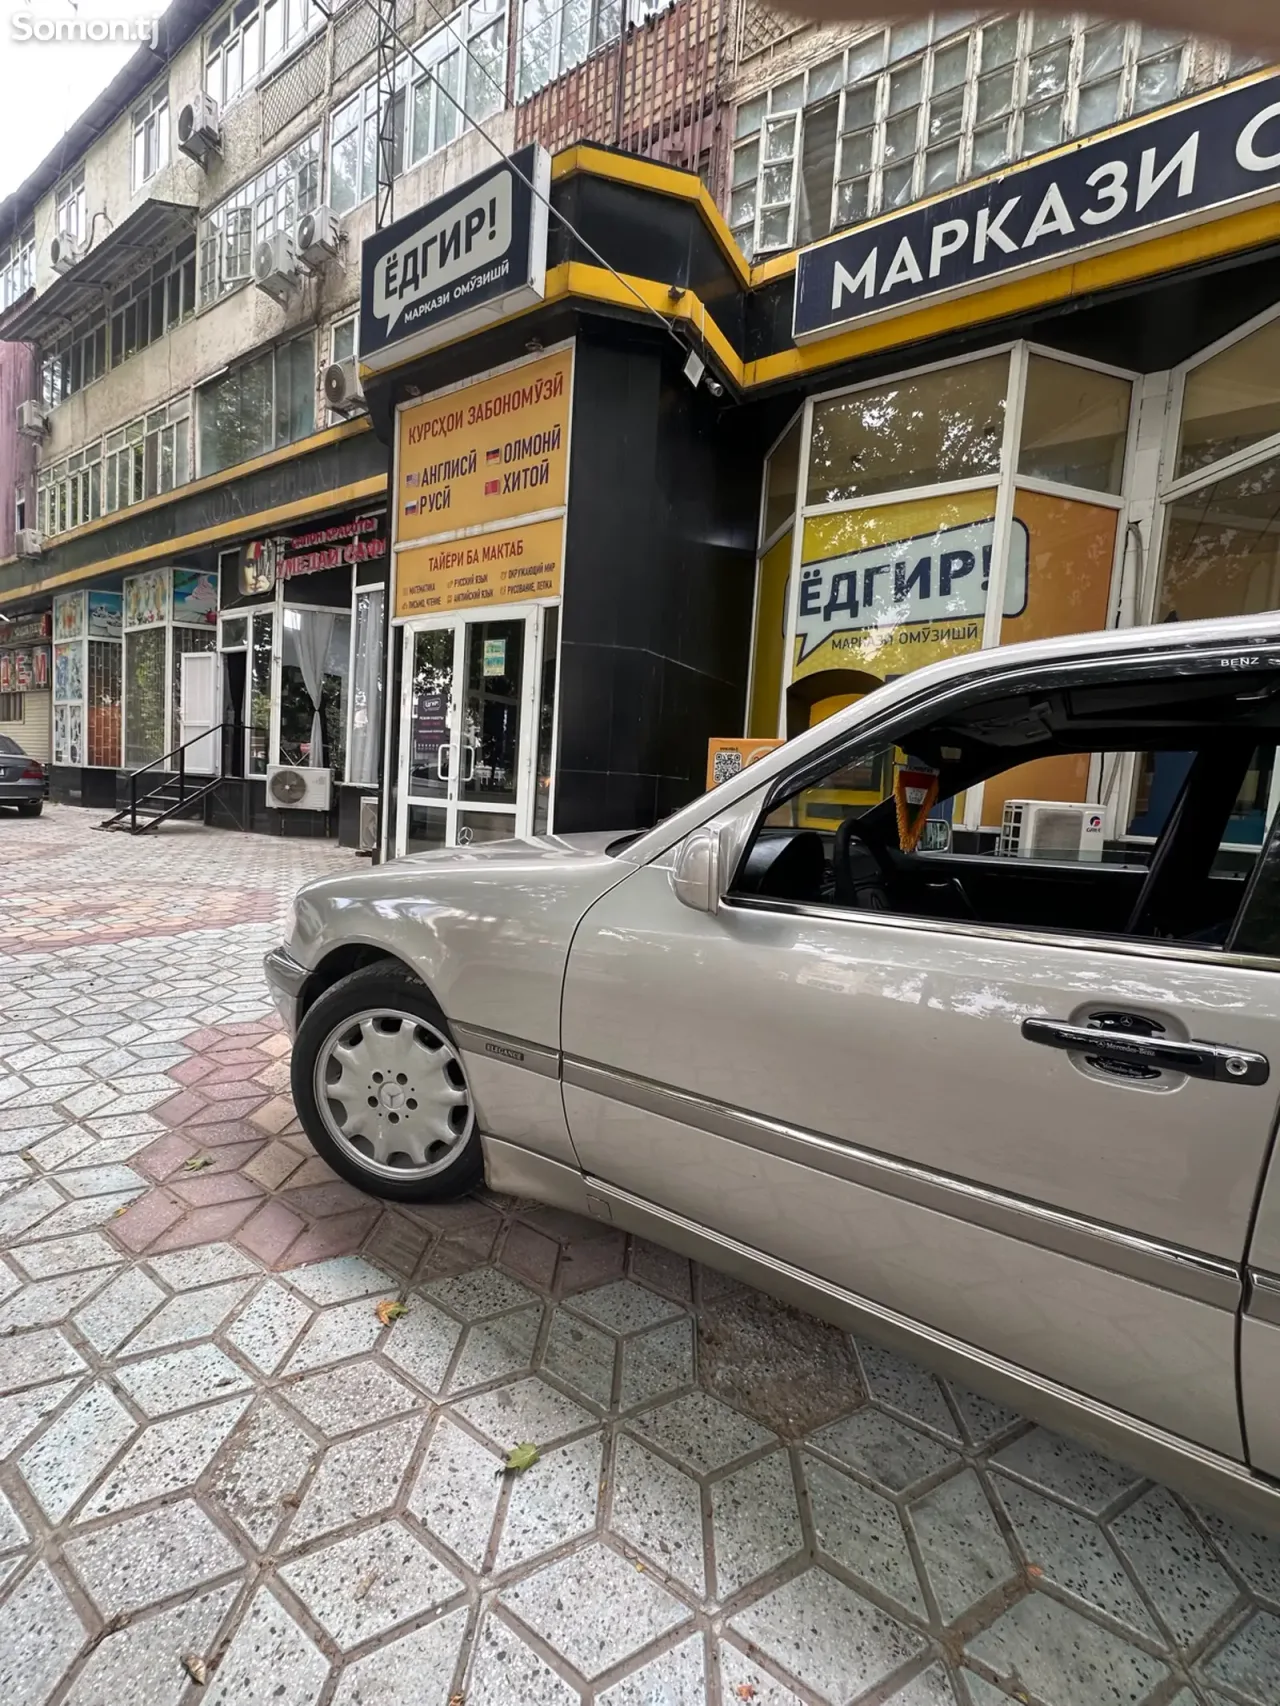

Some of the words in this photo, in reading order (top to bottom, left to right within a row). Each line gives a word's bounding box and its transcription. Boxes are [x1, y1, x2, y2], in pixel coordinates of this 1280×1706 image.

[831, 130, 1199, 310] МАРКАЗИ
[385, 197, 496, 300] ЁДГИР!
[404, 291, 450, 323] МАРКАЗИ
[453, 259, 509, 298] ОМӮЗИШӢ
[408, 410, 463, 445] КУРСҲОИ
[467, 371, 564, 425] ЗАБОНОМӮЗӢ
[504, 424, 561, 463] ОЛМОНӢ
[421, 449, 477, 487] АНГЛИСӢ
[502, 459, 549, 494] ХИТОӢ
[420, 485, 451, 514] РУСӢ
[325, 517, 378, 541] КРАСОТЫ
[467, 549, 479, 565] БА
[482, 540, 523, 562] МАКТАБ
[800, 544, 993, 622] ЁДГИР!
[899, 623, 978, 645] ОМӮЗИШӢ
[1221, 657, 1259, 667] BENZ
[486, 1044, 523, 1060] ELEGANCE
[1106, 1042, 1155, 1056] Mercedes-Benz
